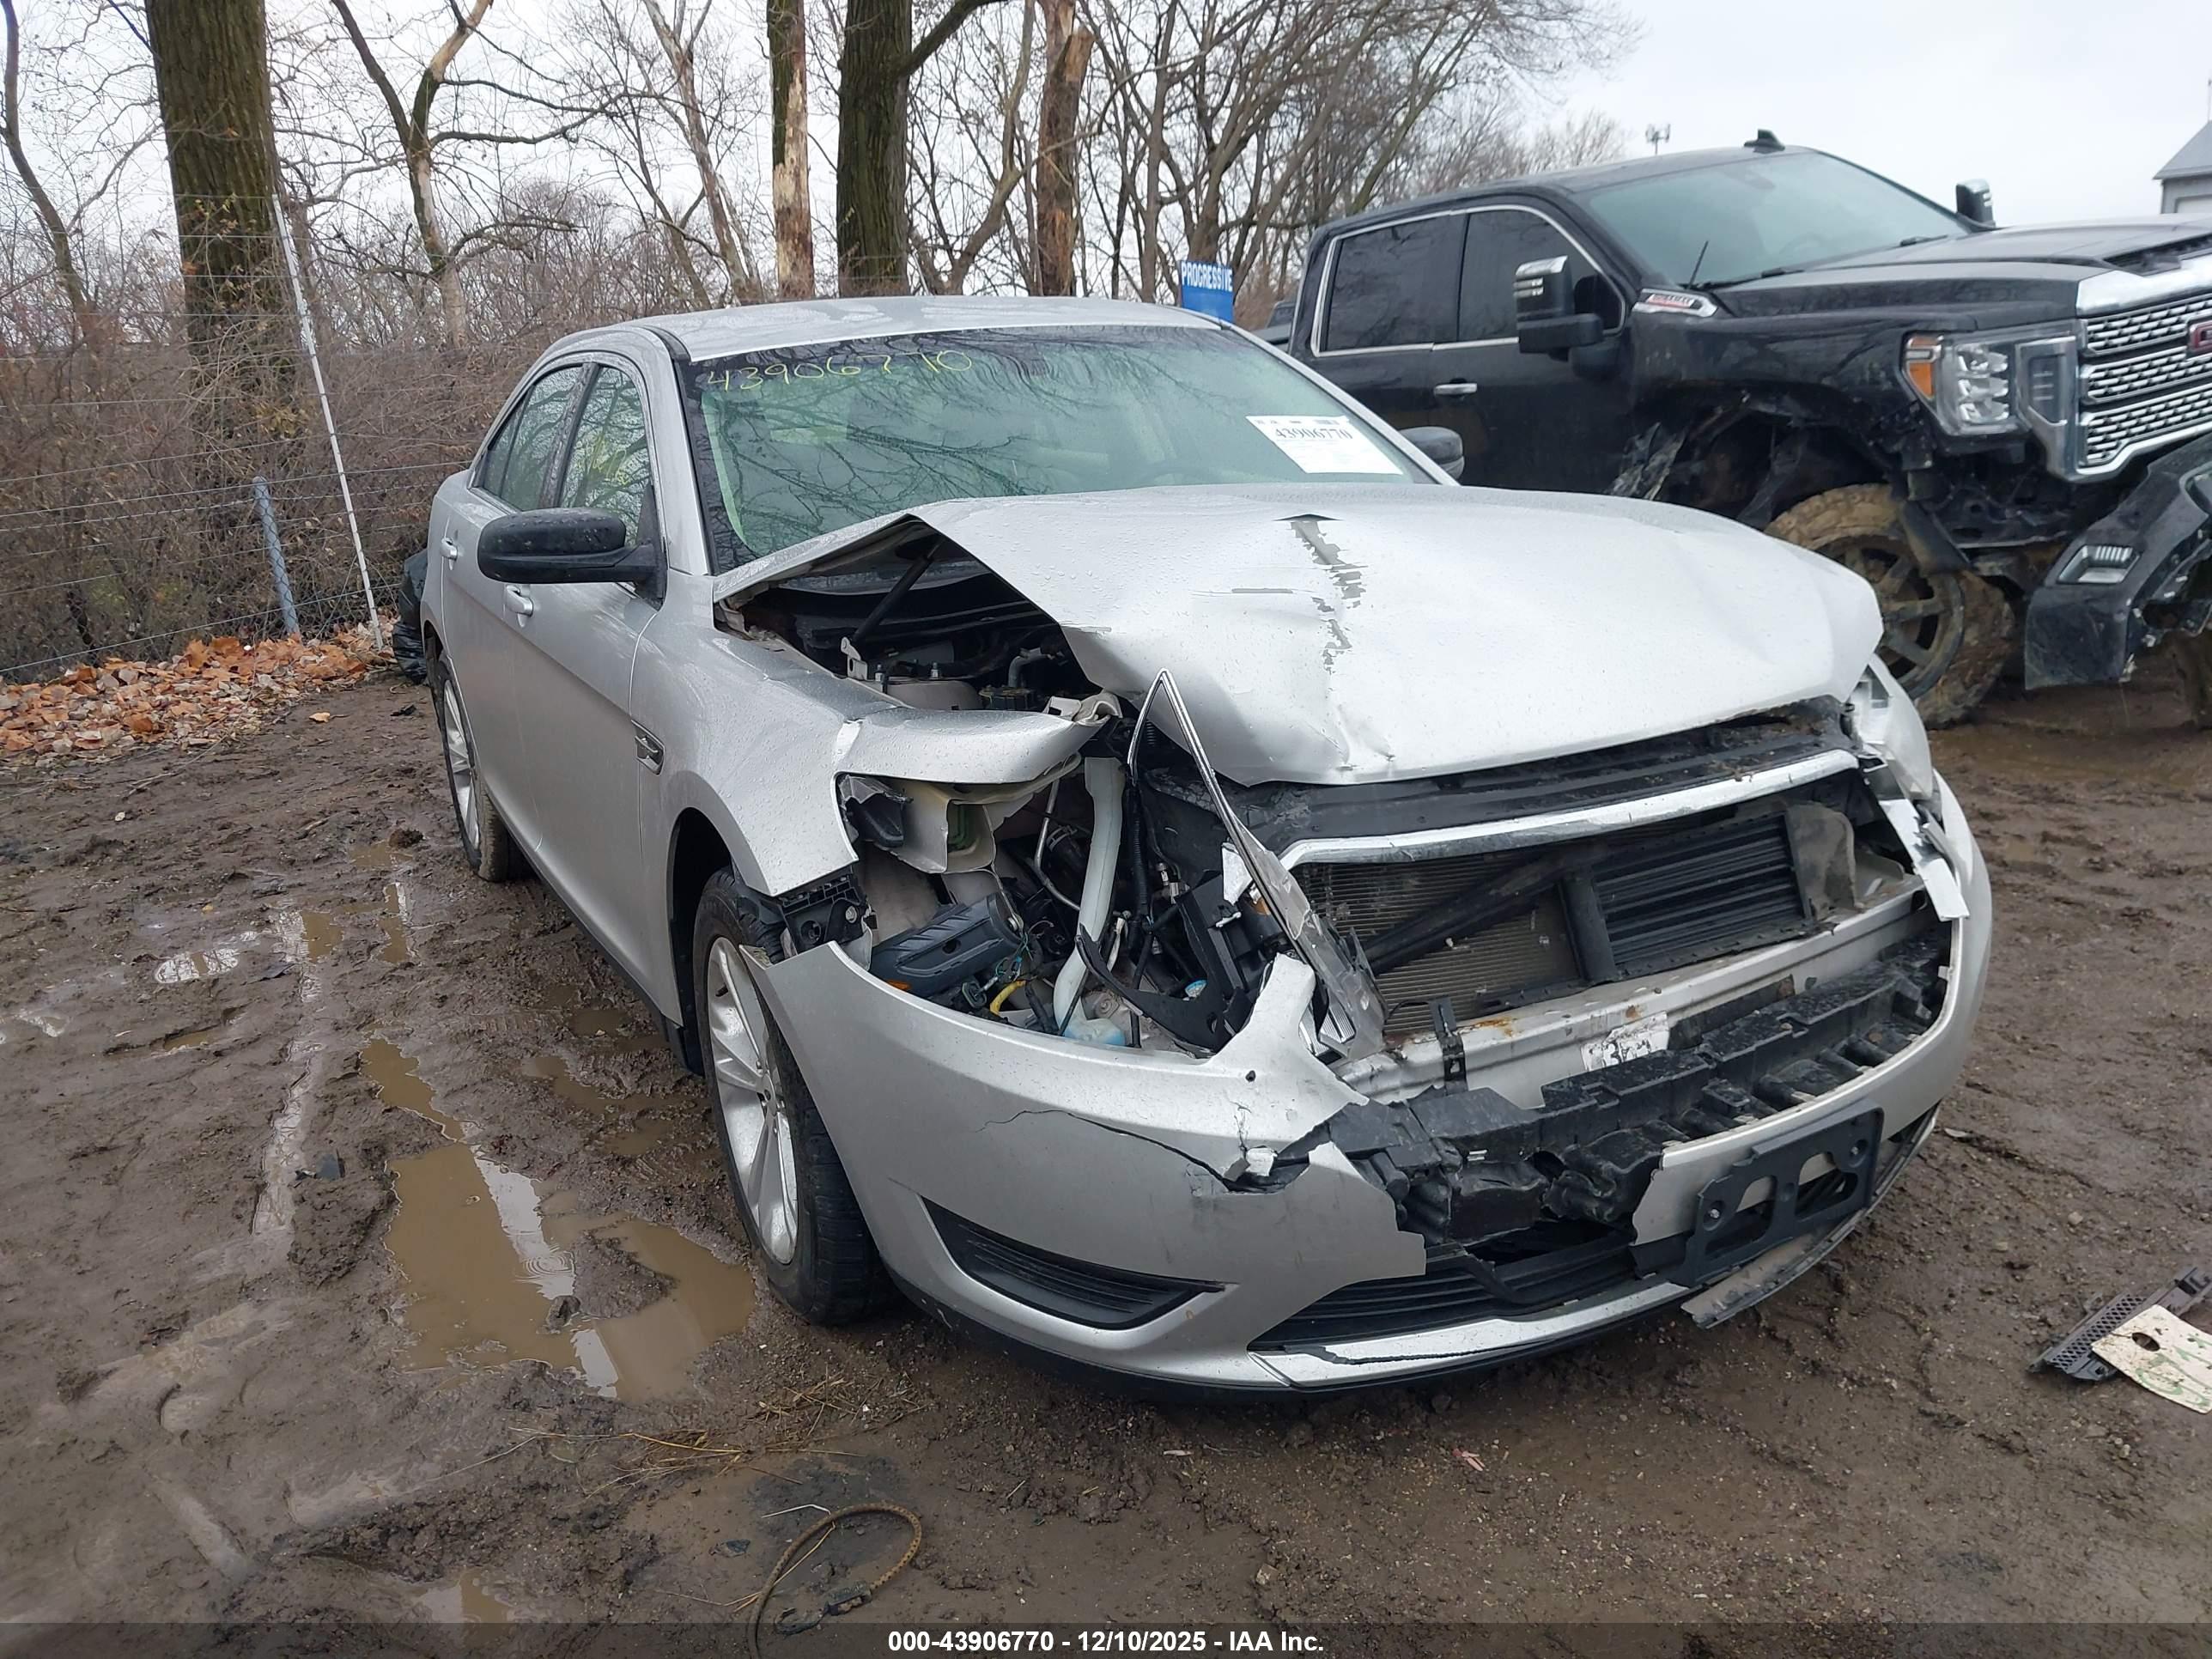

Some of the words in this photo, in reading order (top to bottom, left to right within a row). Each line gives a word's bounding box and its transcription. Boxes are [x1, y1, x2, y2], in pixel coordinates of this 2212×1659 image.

[1181, 261, 1233, 292] PROGRESSIVE
[707, 349, 972, 392] 43906770
[1275, 428, 1353, 440] 43906770
